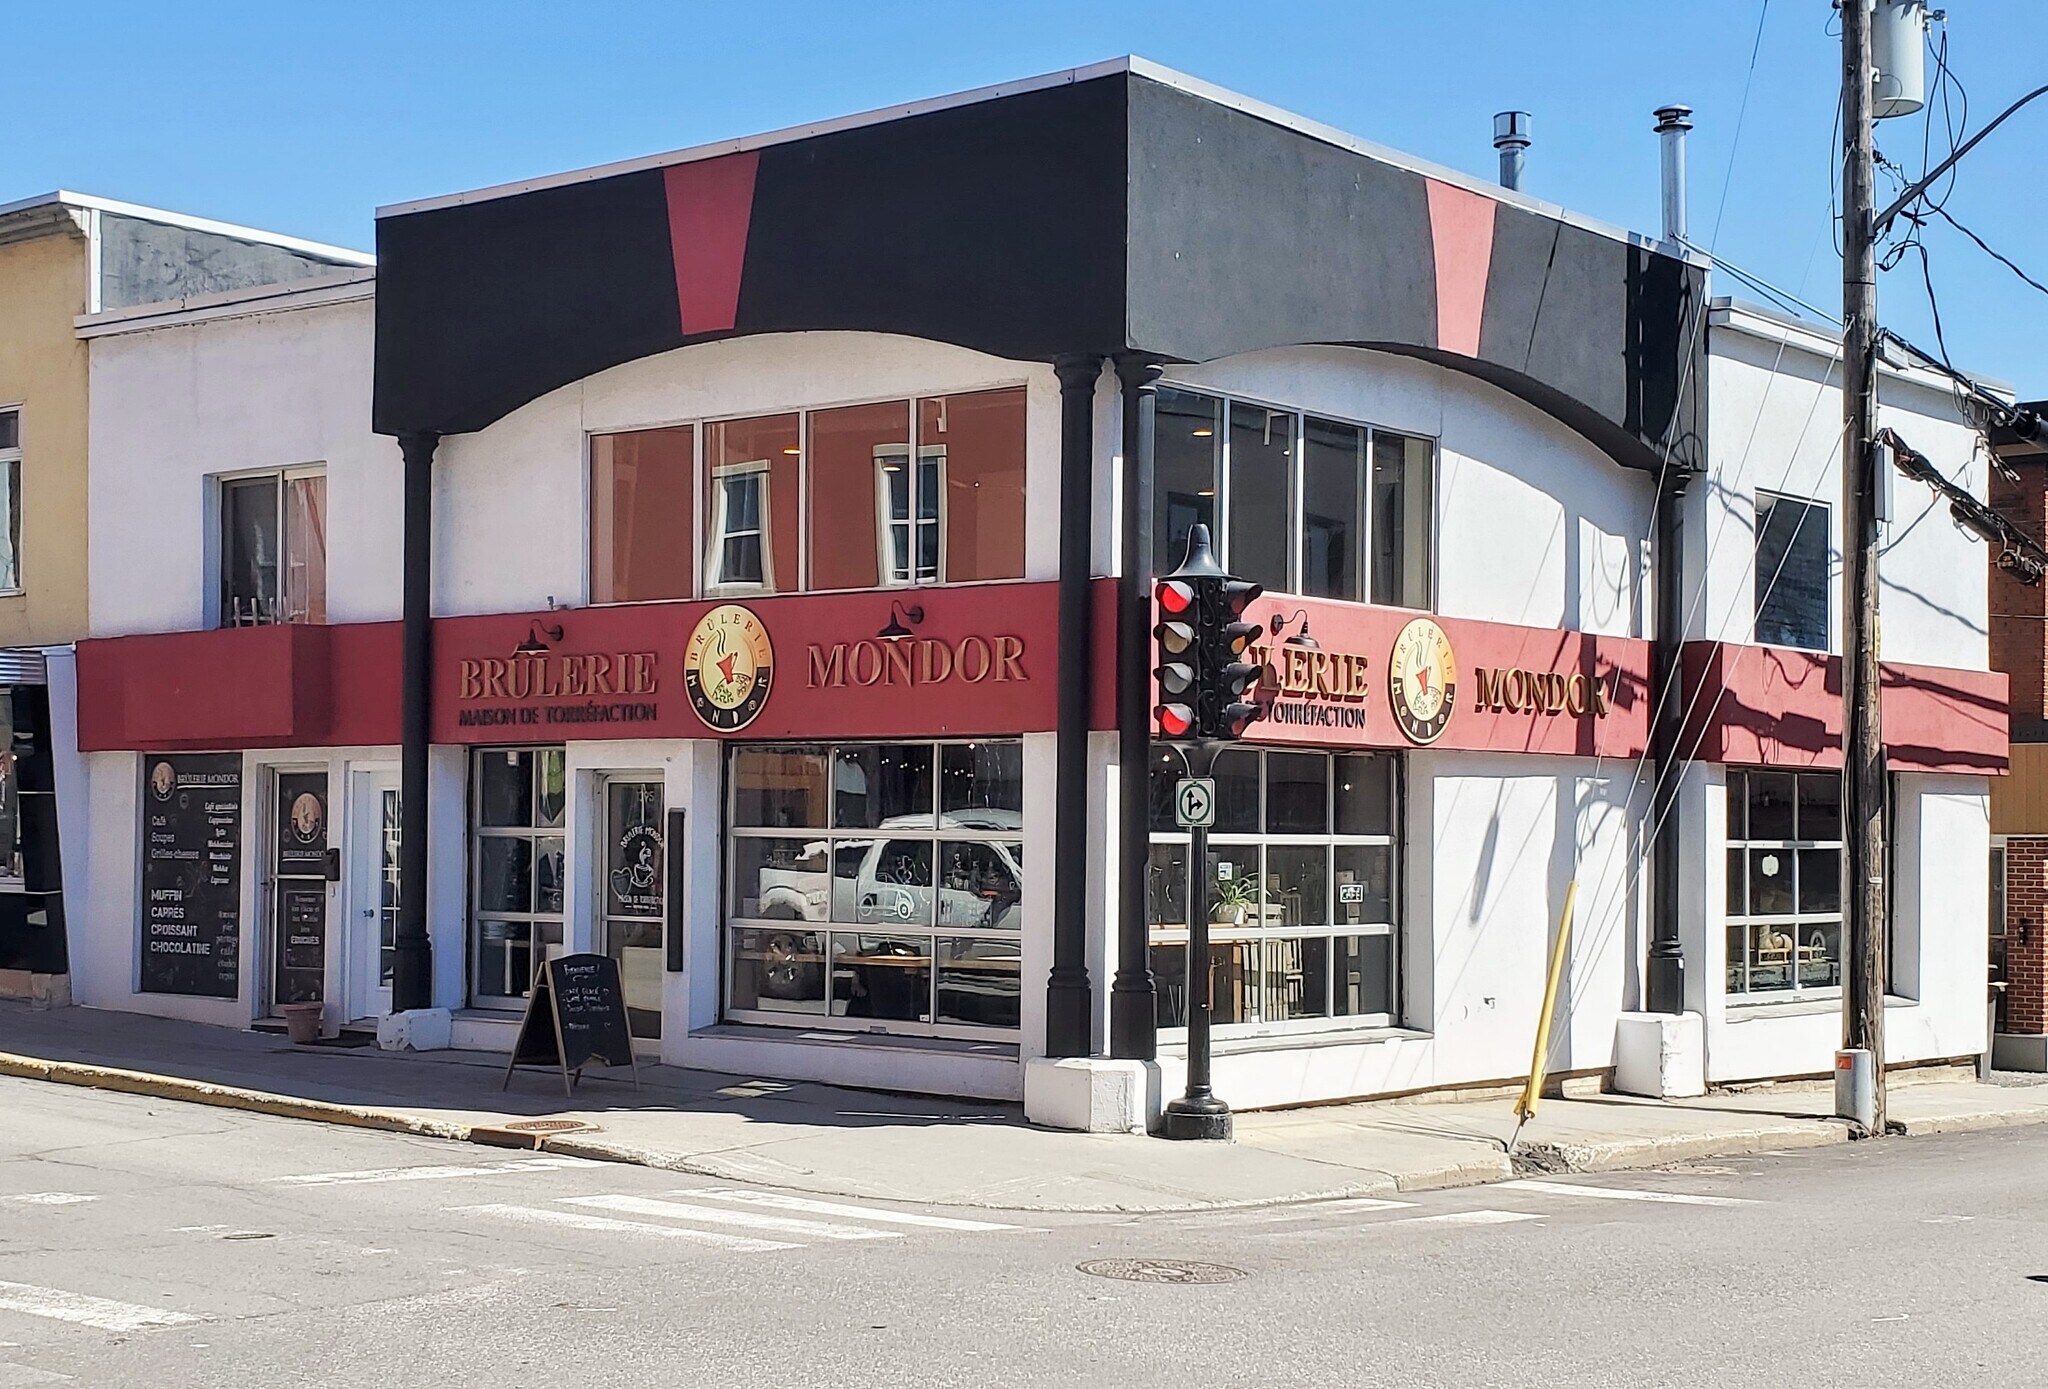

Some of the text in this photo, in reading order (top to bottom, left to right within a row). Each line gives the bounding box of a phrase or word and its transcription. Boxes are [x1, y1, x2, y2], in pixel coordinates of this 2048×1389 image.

[690, 613, 767, 662] BRÛLERIE
[805, 635, 1028, 689] MONDOR
[458, 647, 659, 699] BRÛLERIE
[1474, 666, 1610, 719] MONDOR
[459, 700, 658, 726] MAISON DE TORRÉFACTION
[686, 674, 767, 725] MONDOR
[151, 889, 182, 901] MUFFIN
[150, 941, 211, 955] CHOCOLATINE
[151, 923, 198, 937] CROISSANT
